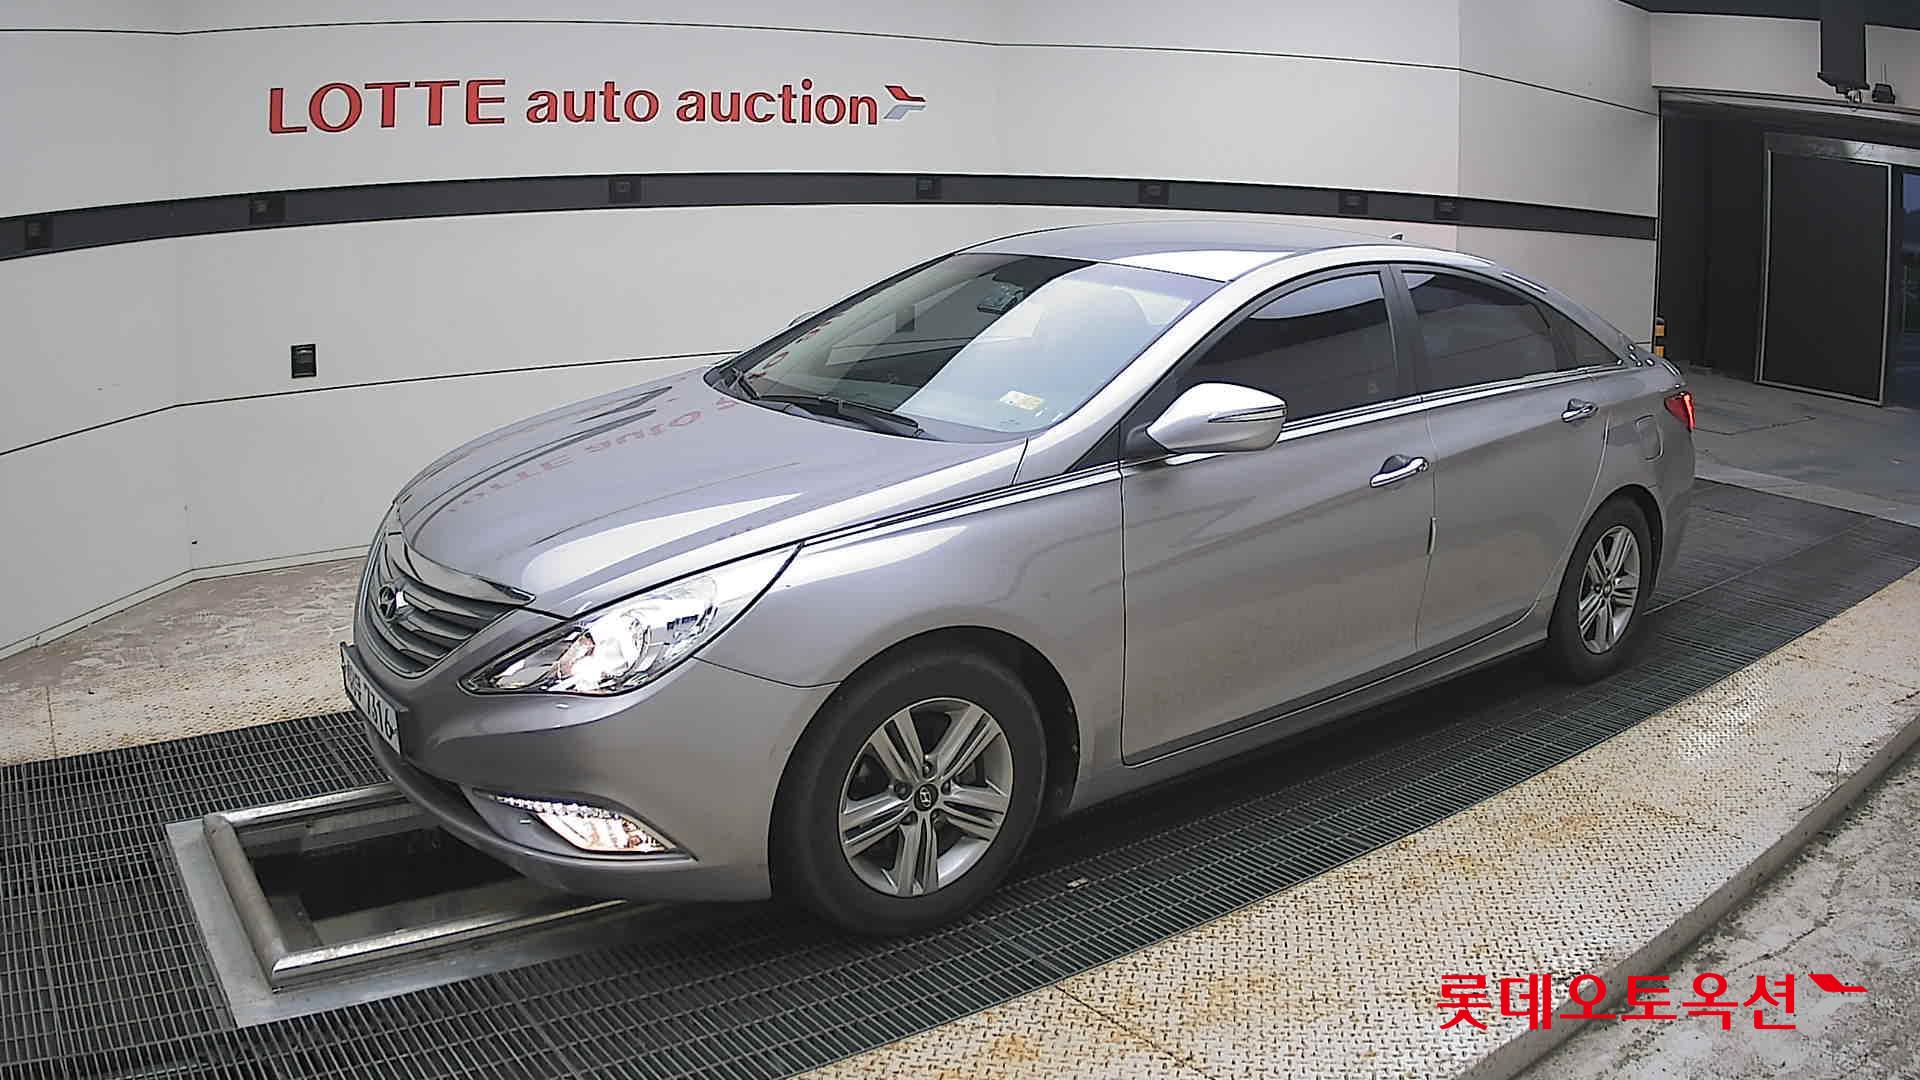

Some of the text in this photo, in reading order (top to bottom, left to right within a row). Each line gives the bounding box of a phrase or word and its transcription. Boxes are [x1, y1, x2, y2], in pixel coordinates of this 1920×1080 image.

[268, 79, 878, 135] LOTTE auto auction
